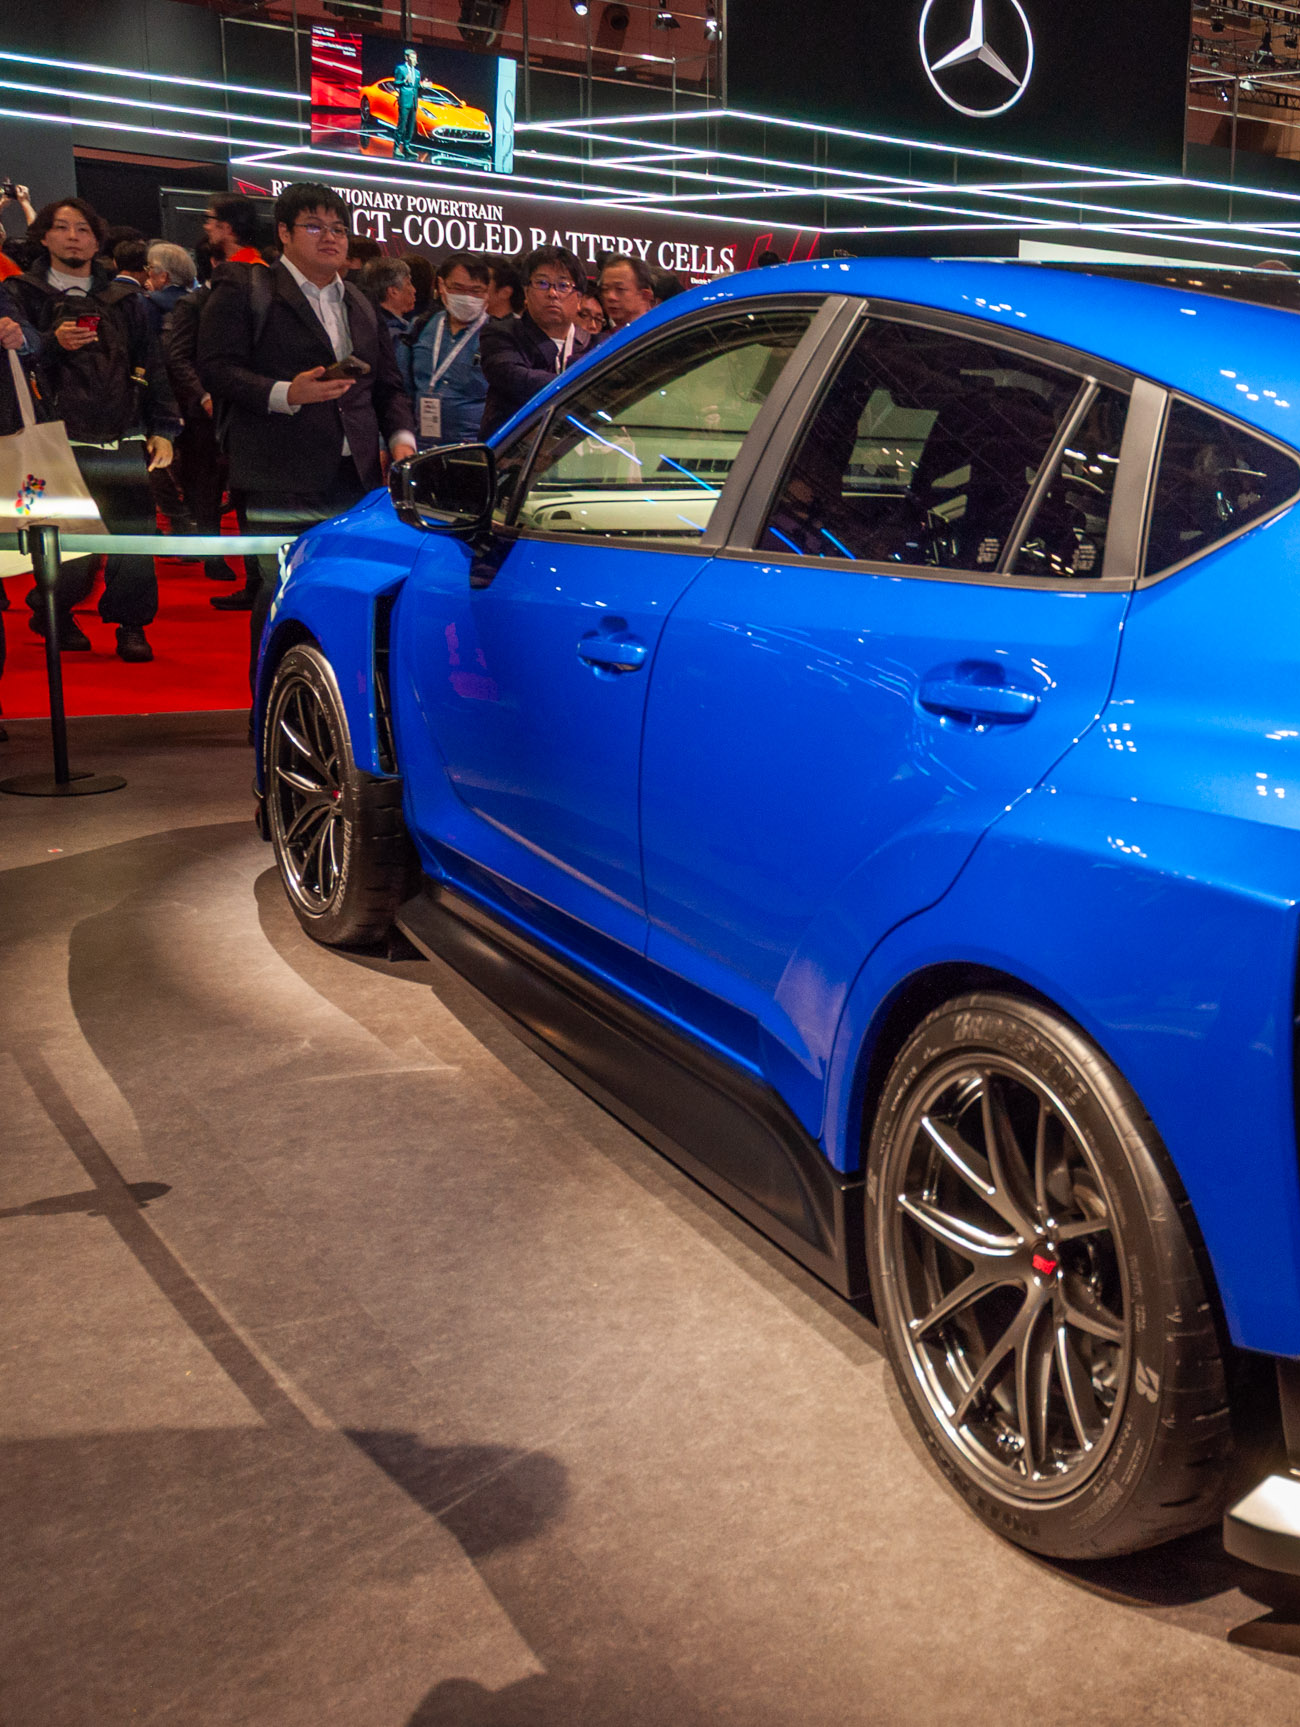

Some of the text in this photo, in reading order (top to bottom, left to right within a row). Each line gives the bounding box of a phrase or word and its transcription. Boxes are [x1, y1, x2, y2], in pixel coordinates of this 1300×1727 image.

[270, 179, 503, 222] RTIONARY POWERTRAIN
[353, 208, 523, 255] CT-COOLED
[657, 241, 735, 274] CELLS
